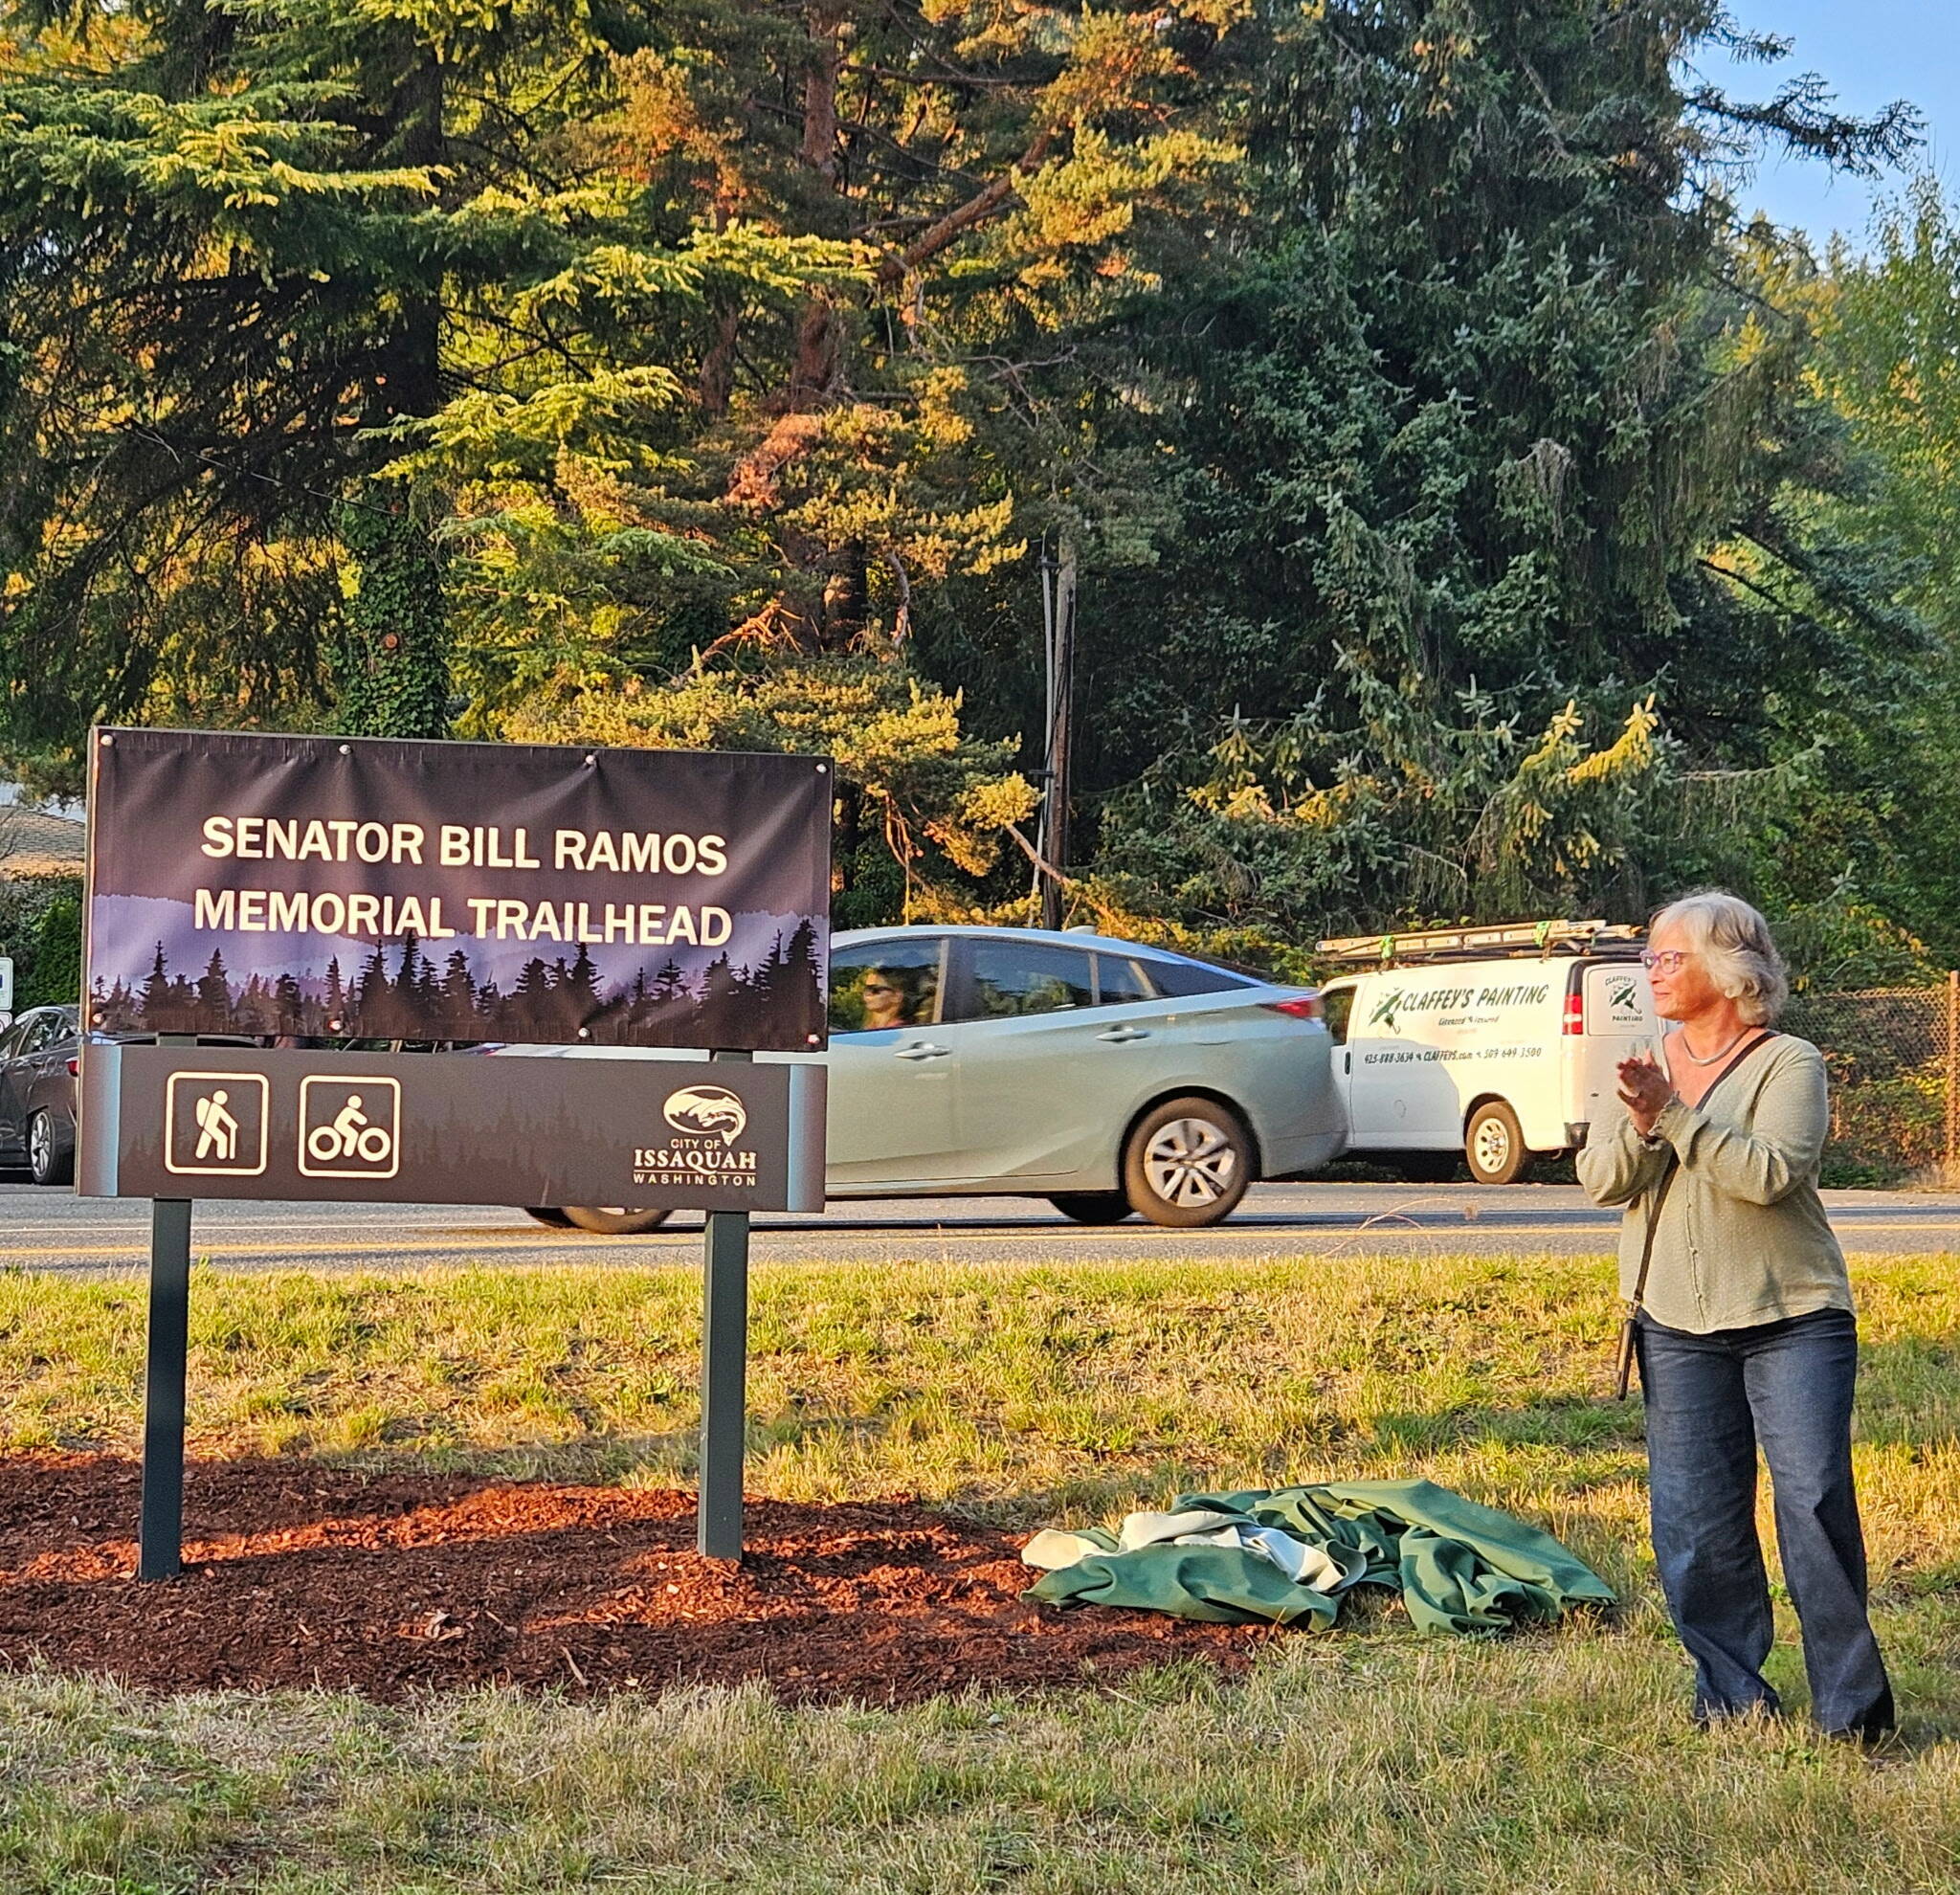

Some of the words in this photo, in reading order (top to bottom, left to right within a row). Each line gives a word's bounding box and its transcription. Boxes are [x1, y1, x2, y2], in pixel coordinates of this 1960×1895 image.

[201, 816, 424, 864] SENATOR
[440, 825, 541, 869] BILL
[554, 829, 727, 876] RAMOS
[194, 889, 456, 938] MEMORIAL
[467, 898, 732, 947] TRAILHEAD
[1402, 989, 1474, 1012] CLAFFEY'S
[1477, 984, 1549, 1007] PAINTING
[670, 1138, 700, 1149] CITY
[703, 1139, 722, 1149] OF
[634, 1148, 757, 1175] ISSAQUAH
[633, 1173, 756, 1187] WASHINGTON
